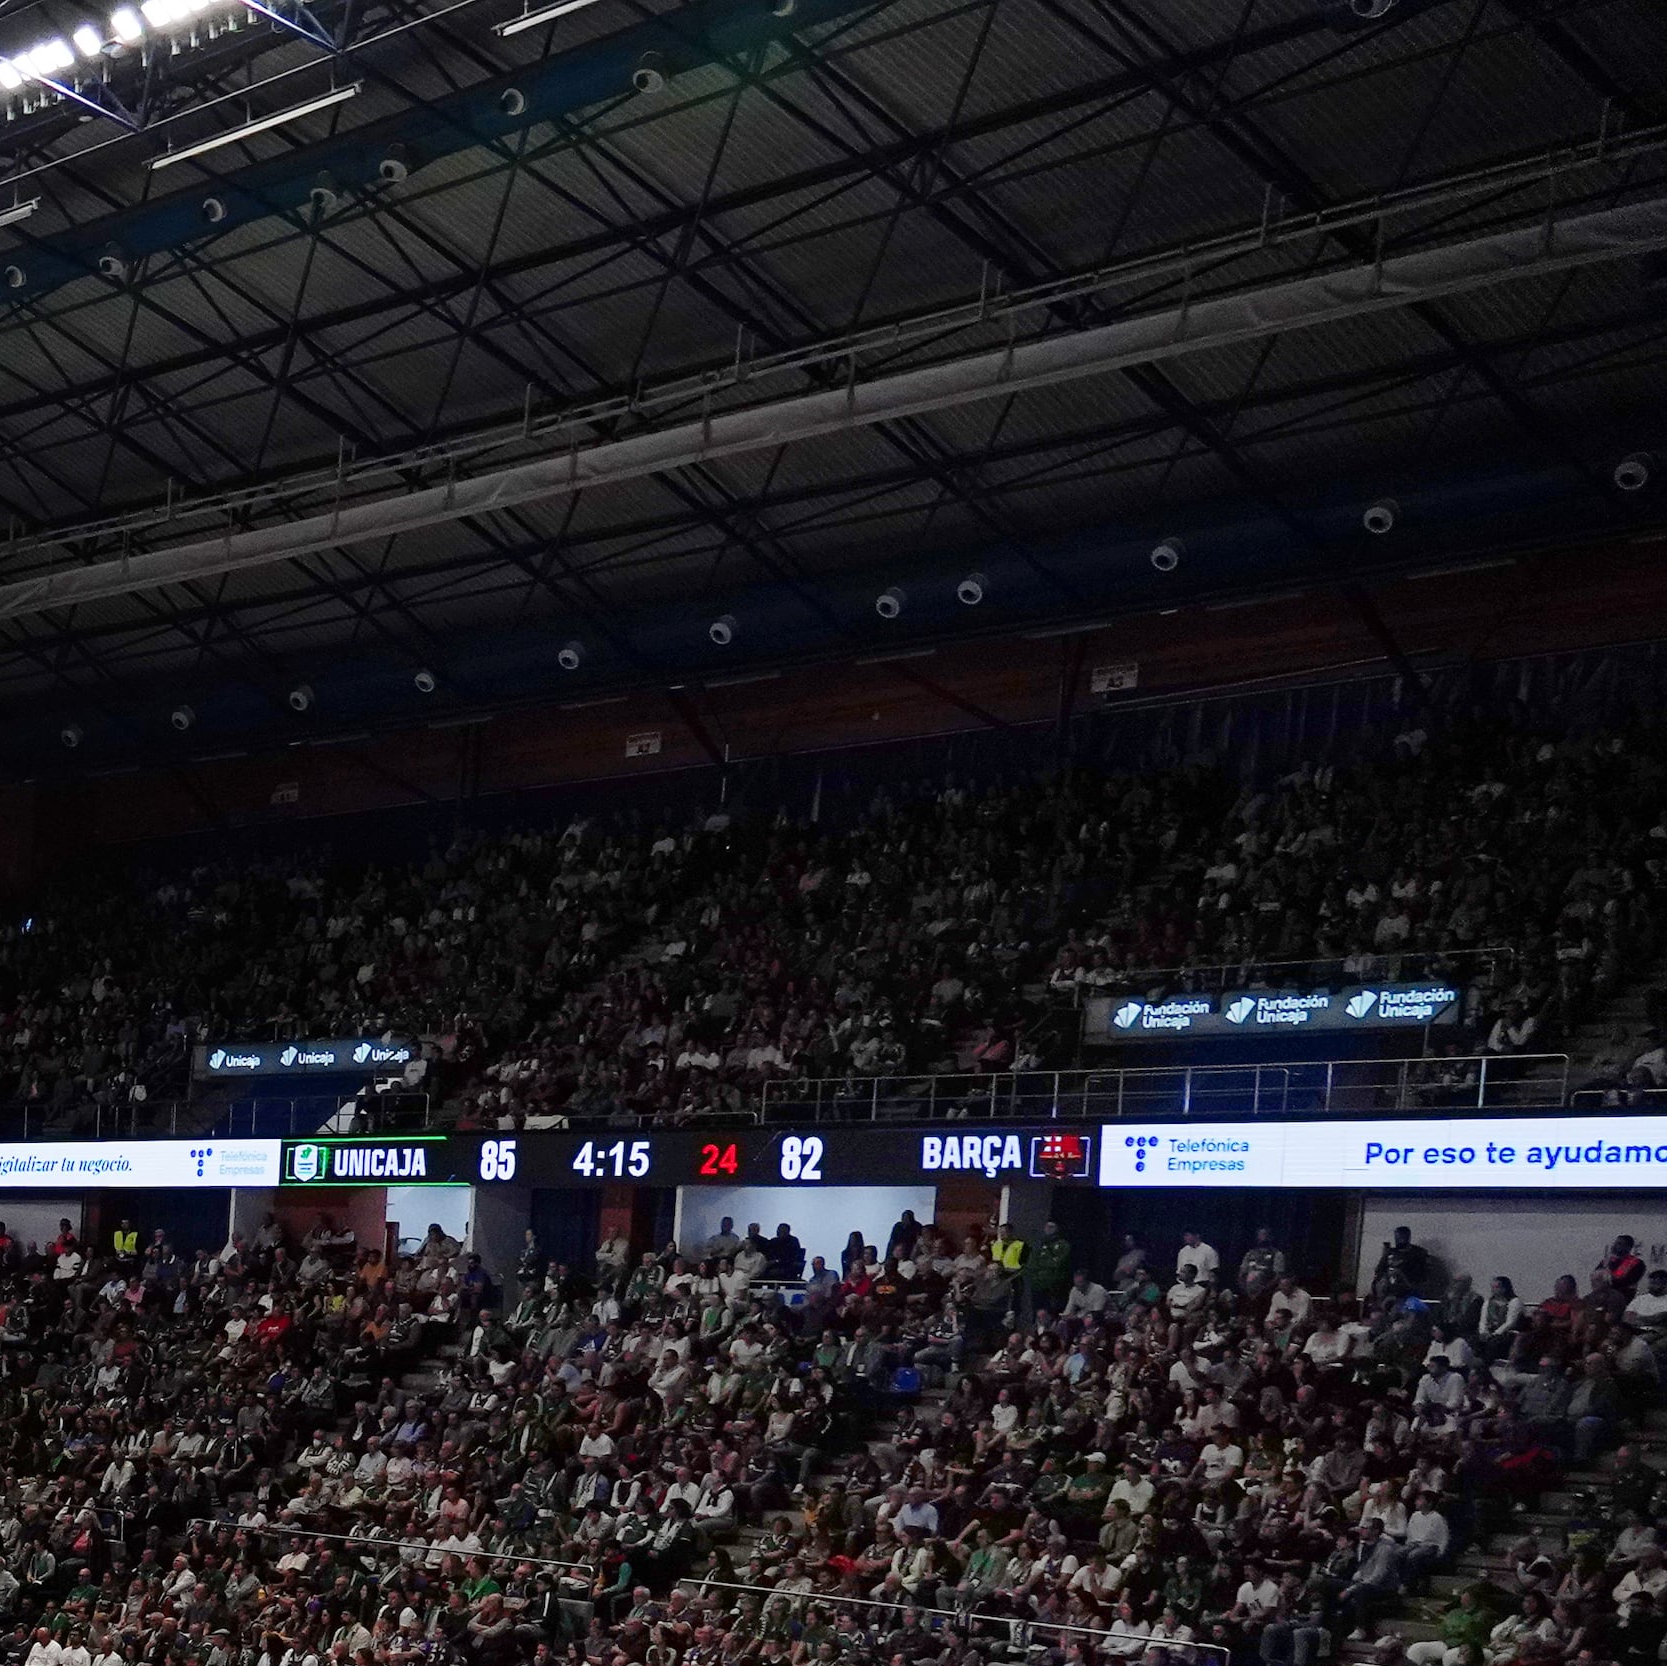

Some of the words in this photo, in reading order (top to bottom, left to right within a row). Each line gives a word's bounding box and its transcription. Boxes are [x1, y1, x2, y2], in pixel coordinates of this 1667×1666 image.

[1143, 1000, 1210, 1018] Fundación
[1256, 995, 1328, 1012] Fundación
[1378, 1001, 1433, 1020] Unicaja
[1142, 1013, 1190, 1031] Unicaja
[1255, 1008, 1308, 1026] Unicaja
[225, 1053, 261, 1070] Unicaja
[297, 1050, 334, 1066] Unicaja
[1168, 1136, 1250, 1154] Telefónica
[1366, 1142, 1414, 1166] Por
[1424, 1146, 1476, 1166] eso
[1486, 1144, 1516, 1166] te
[78, 1157, 133, 1175] negocio.
[334, 1148, 427, 1178] UNICAJA
[479, 1140, 516, 1181] 85
[572, 1141, 651, 1179] 4:15
[700, 1143, 738, 1175] 24
[781, 1136, 824, 1181] 82
[922, 1136, 1023, 1179] BARÇA
[1167, 1156, 1246, 1175] Empresas
